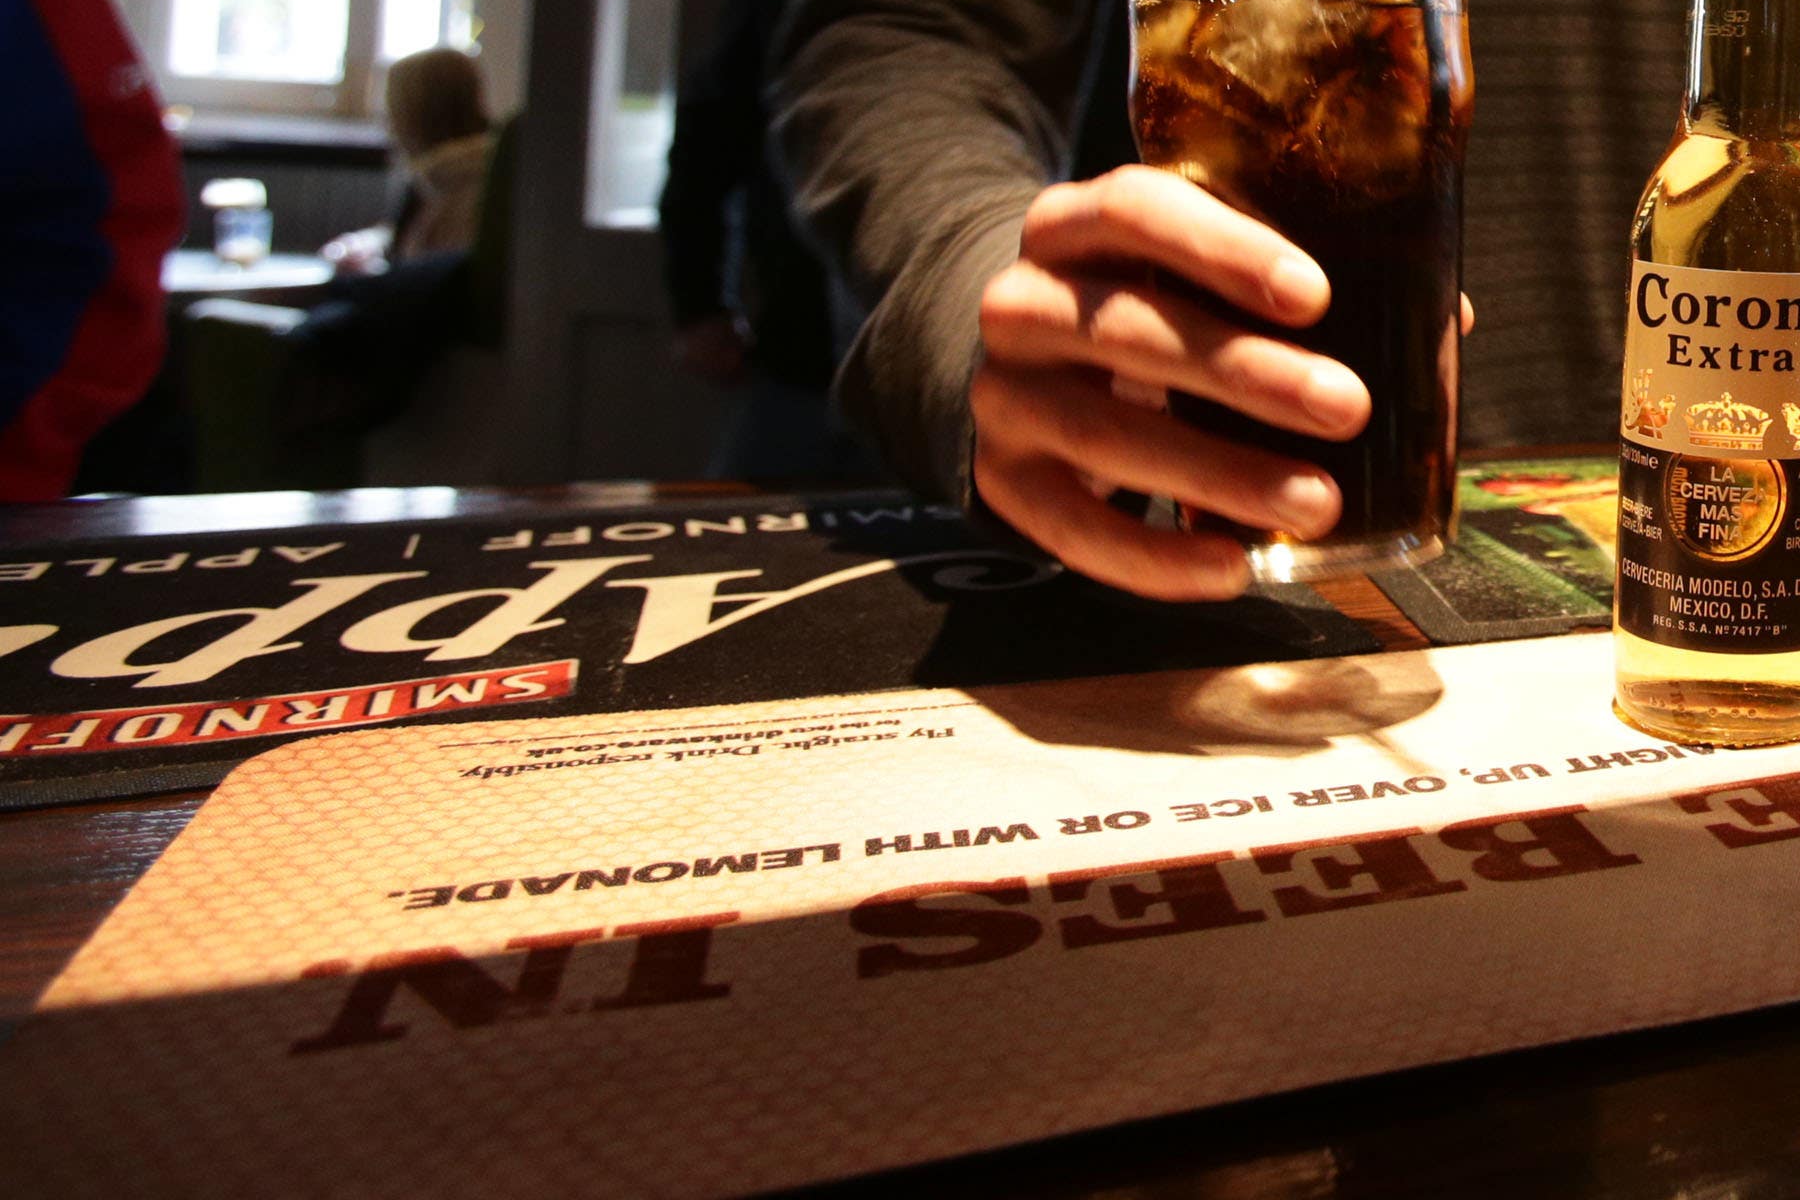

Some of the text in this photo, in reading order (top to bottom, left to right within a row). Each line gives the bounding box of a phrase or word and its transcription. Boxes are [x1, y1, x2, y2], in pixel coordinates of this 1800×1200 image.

[1666, 334, 1795, 372] Extra
[1710, 466, 1736, 483] LA
[1680, 481, 1766, 504] CERVEZA
[1701, 503, 1744, 522] MAS
[1698, 522, 1745, 541] FINA
[1622, 557, 1684, 593] CERVECERIA
[1688, 577, 1757, 601] MODELO,
[1761, 580, 1792, 598] S.A.
[1652, 614, 1676, 629] REG.
[1669, 595, 1769, 622] MEXICO, D.F.
[839, 720, 871, 730] the
[906, 726, 956, 740] Fly
[525, 729, 785, 759] drinkaware.co.uk
[665, 743, 762, 762] Drink
[457, 752, 654, 780] responsibly.
[1459, 763, 1552, 785] UP,
[1288, 775, 1448, 808] OVER
[1169, 795, 1275, 823] ICE
[1057, 810, 1152, 836] OR
[864, 822, 1042, 858] WITH
[387, 841, 843, 912] LEMONADE.
[850, 802, 1643, 980] BEES
[288, 910, 742, 1056] IN
